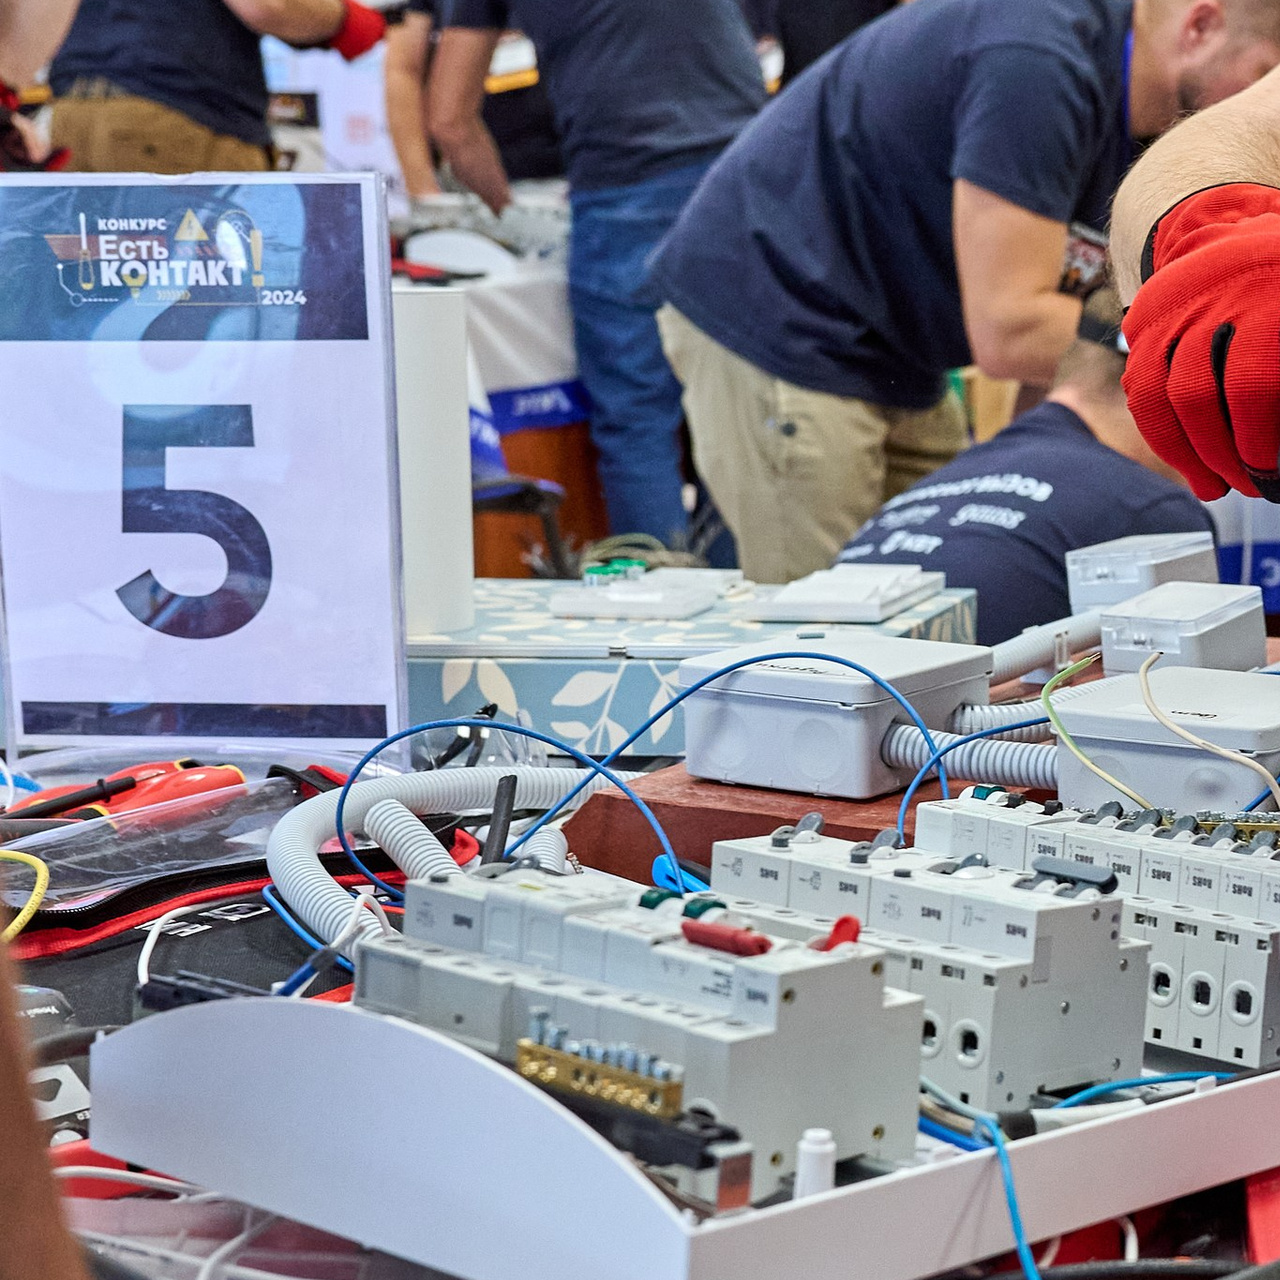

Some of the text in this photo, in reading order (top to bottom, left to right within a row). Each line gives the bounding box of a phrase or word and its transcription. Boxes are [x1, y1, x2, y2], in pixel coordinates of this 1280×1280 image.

[97, 218, 167, 231] КОНКУРС
[261, 289, 307, 306] 2024
[115, 403, 273, 640] 5
[1112, 862, 1131, 876] RoHS
[1151, 868, 1172, 882] RoHS
[1192, 875, 1213, 890] RoHS
[1232, 883, 1253, 898] RoHS
[1006, 924, 1028, 938] RoHS
